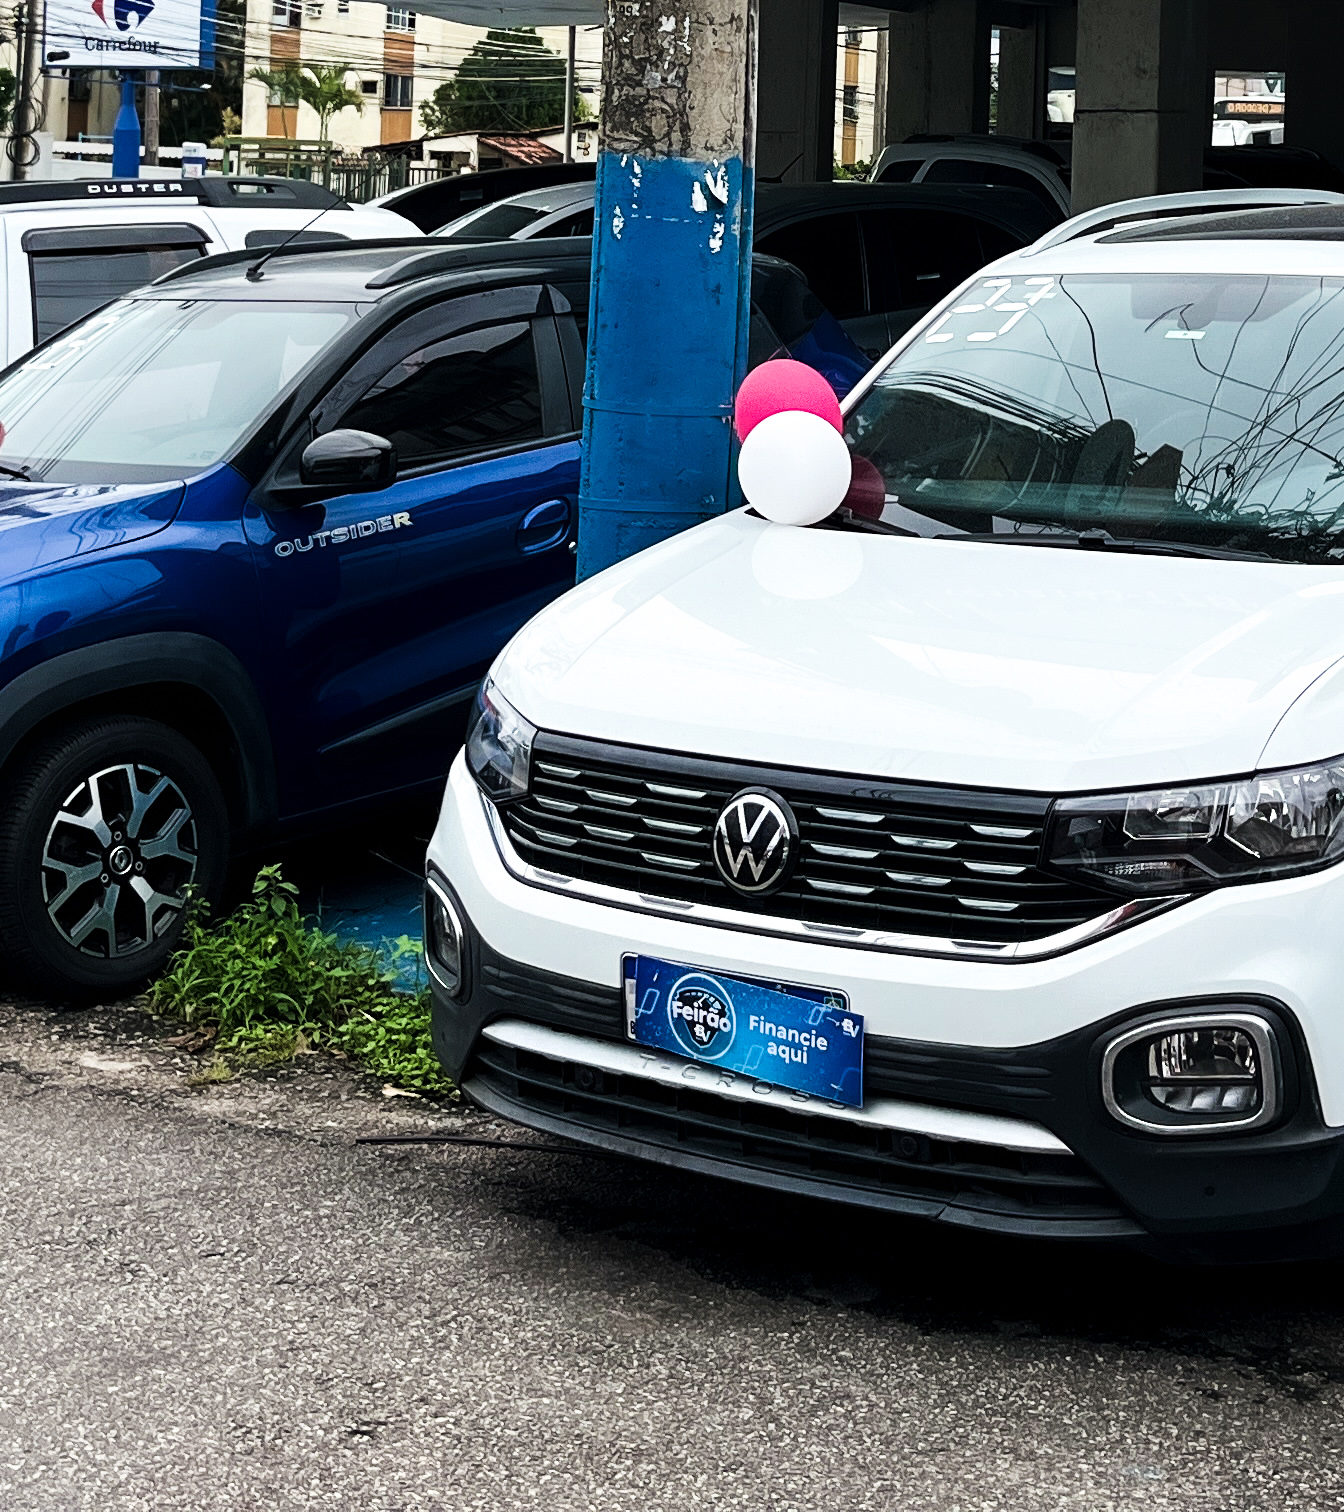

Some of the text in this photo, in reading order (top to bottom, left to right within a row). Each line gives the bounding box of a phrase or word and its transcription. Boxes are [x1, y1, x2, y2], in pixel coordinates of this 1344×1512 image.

[84, 35, 160, 53] Carrefour
[87, 183, 183, 194] DUSTER
[925, 276, 1056, 344] 23
[274, 511, 414, 557] OUTSIDER
[671, 1000, 732, 1033] Feirão
[749, 1015, 829, 1052] Financie
[766, 1041, 808, 1065] aqui
